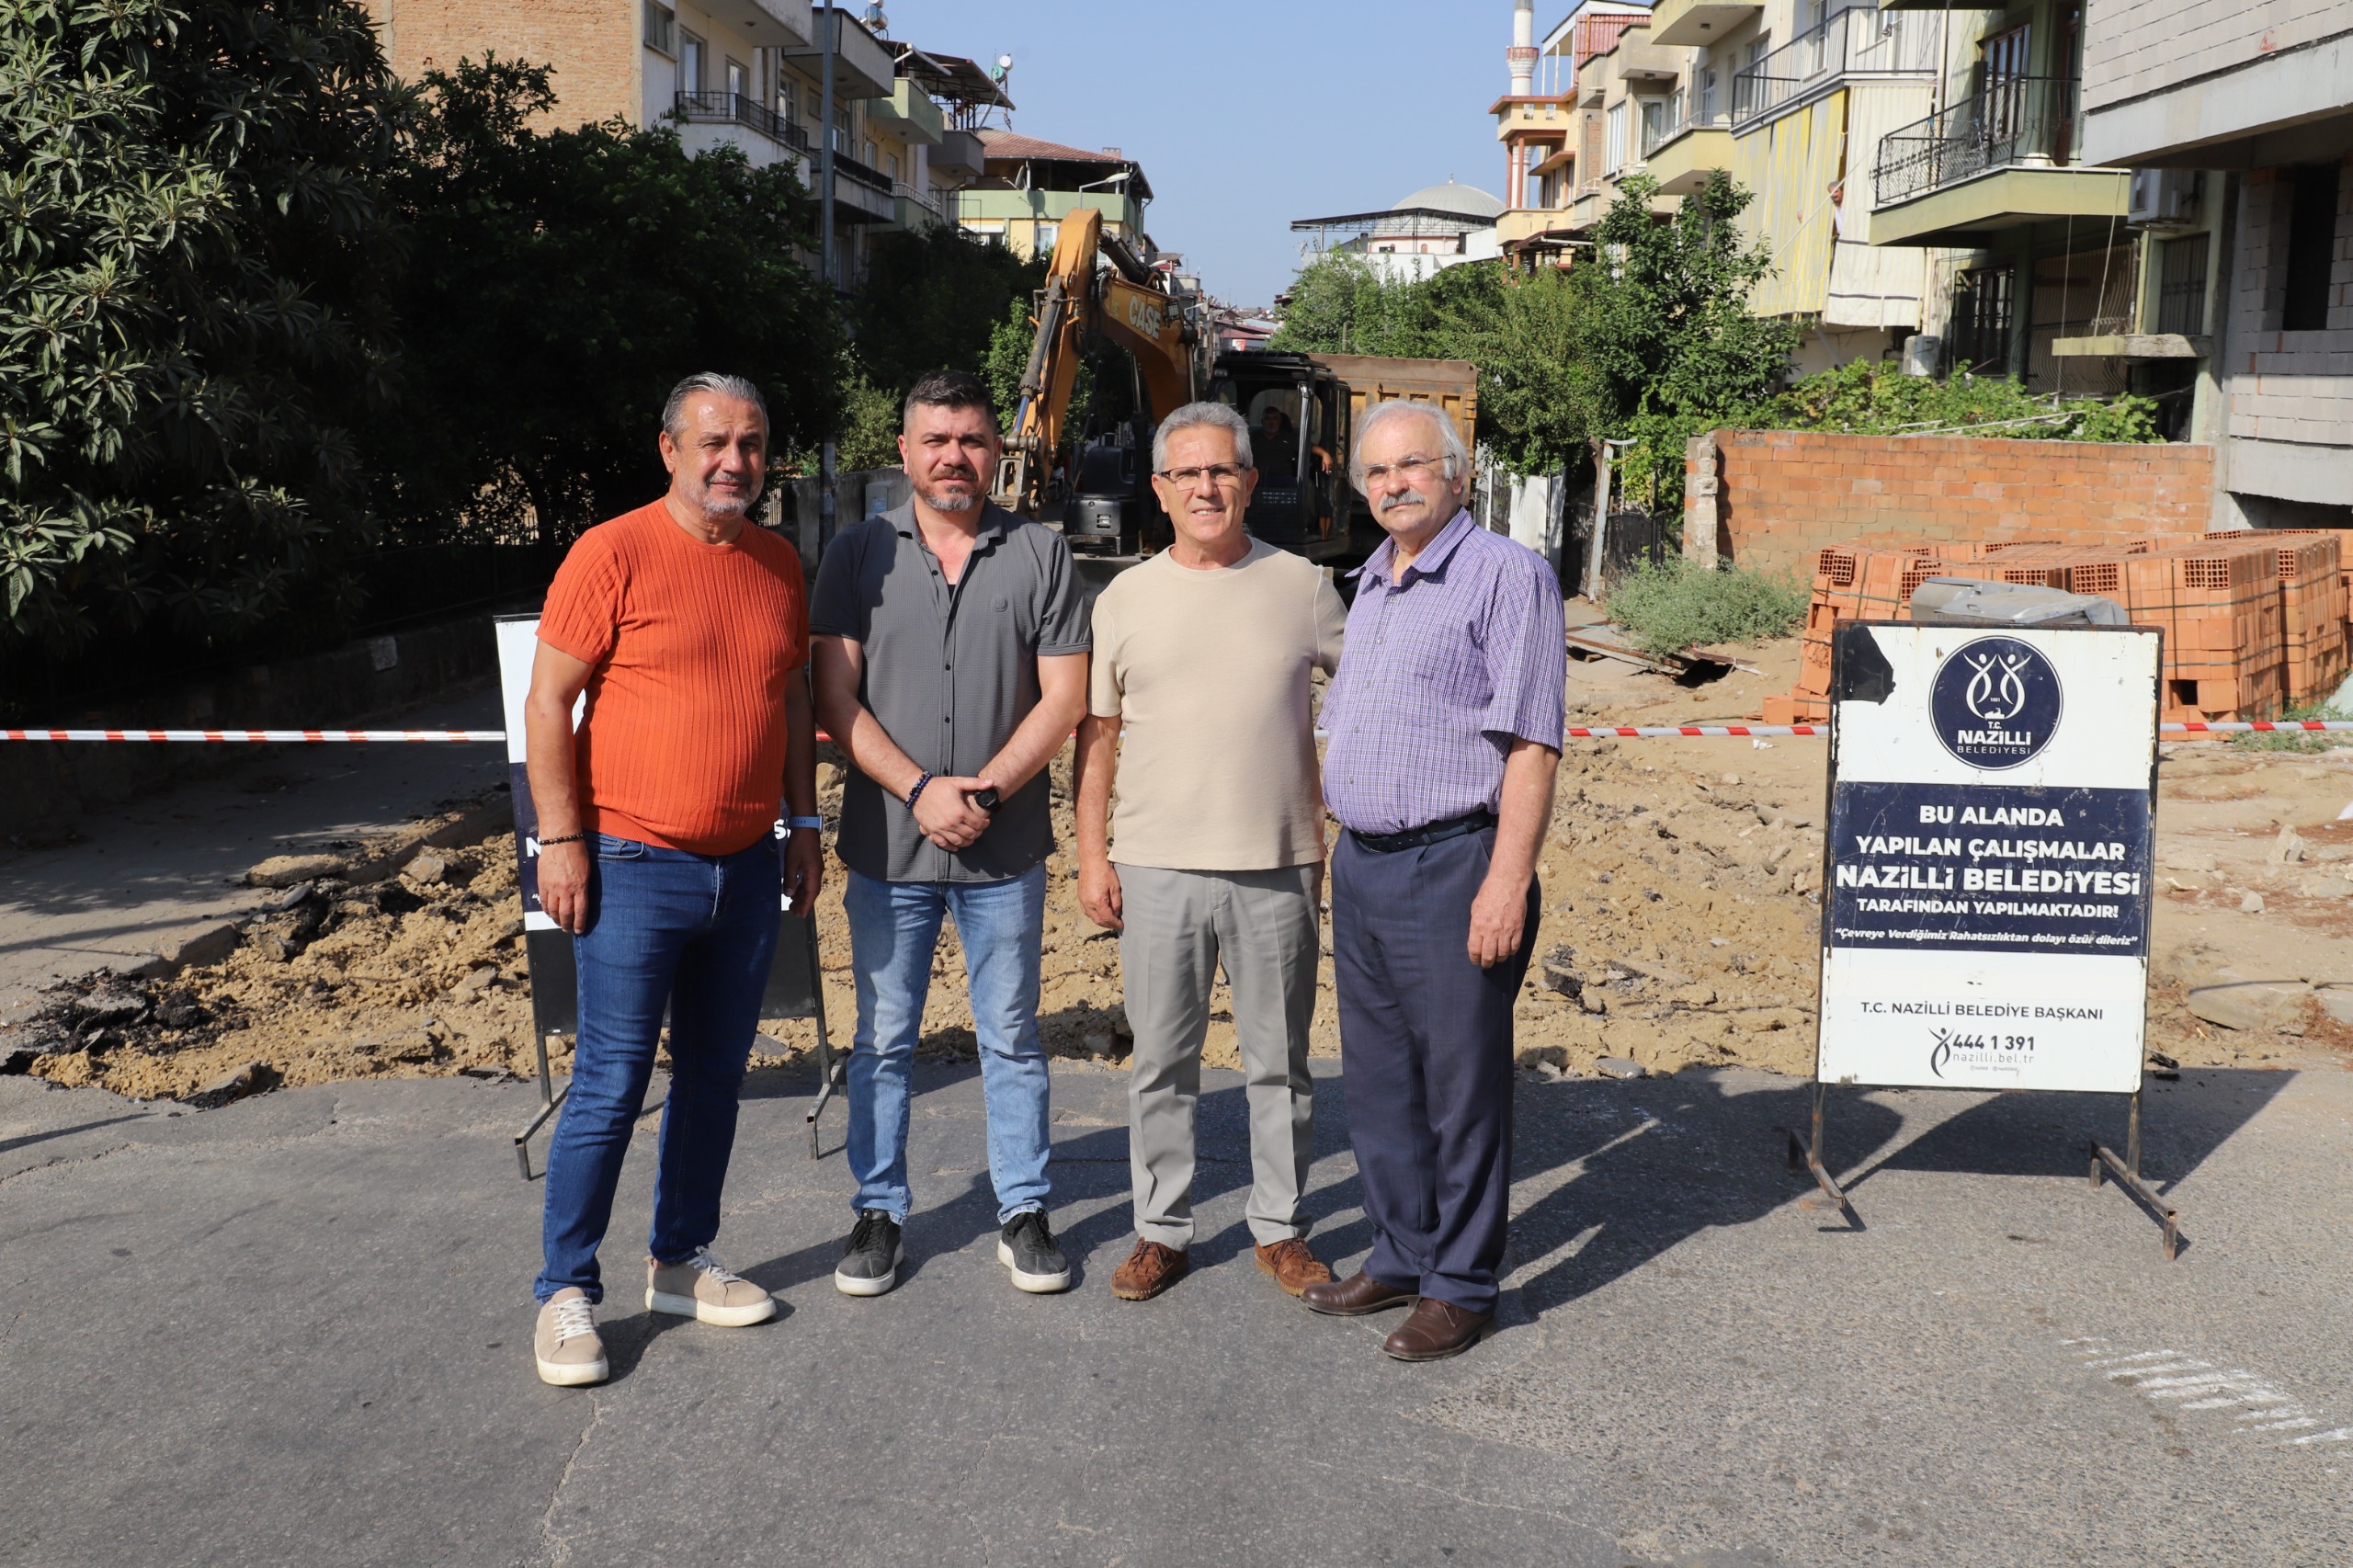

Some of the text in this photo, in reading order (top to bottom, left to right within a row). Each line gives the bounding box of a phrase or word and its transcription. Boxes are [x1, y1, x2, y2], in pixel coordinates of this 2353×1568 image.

[1129, 294, 1162, 340] CASE
[1987, 722, 2002, 730] T.C.
[1919, 805, 2064, 827] BU ALANDA
[1855, 835, 2126, 864] YAPILAN ÇALIŞMALAR
[1856, 898, 2120, 919] TARAFINDAN YAPILMAKTADIR!
[1888, 928, 1948, 942] Verdiğimiz
[1949, 930, 2029, 942] Rahatsızlıktan
[2030, 933, 2067, 946] dolayı
[2067, 933, 2095, 945] özür
[1860, 1001, 2103, 1022] T.C. NAZİLLİ BELEDİYE BAŞKANI
[1952, 1034, 2034, 1051] 444 1 391
[1953, 1052, 2035, 1063] nazilli.bel.tr
